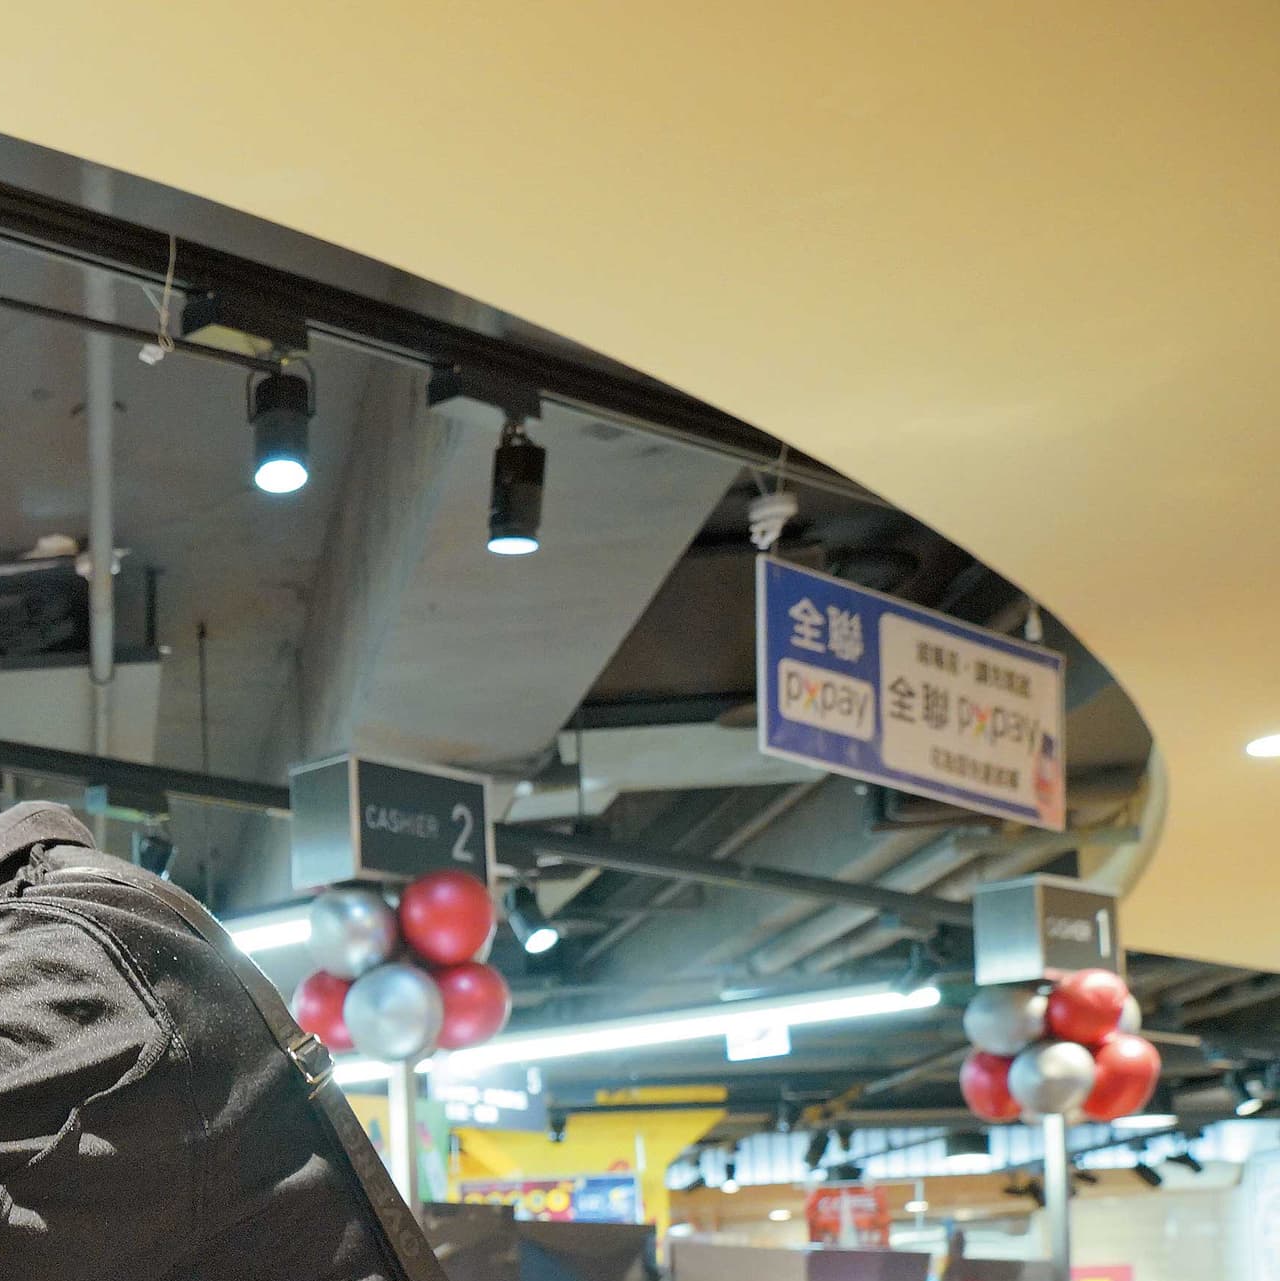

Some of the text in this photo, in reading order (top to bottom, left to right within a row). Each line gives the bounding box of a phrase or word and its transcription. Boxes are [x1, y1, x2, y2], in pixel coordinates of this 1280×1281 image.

[783, 670, 871, 728] pxpay
[451, 803, 474, 863] 2
[1096, 908, 1111, 957] 1
